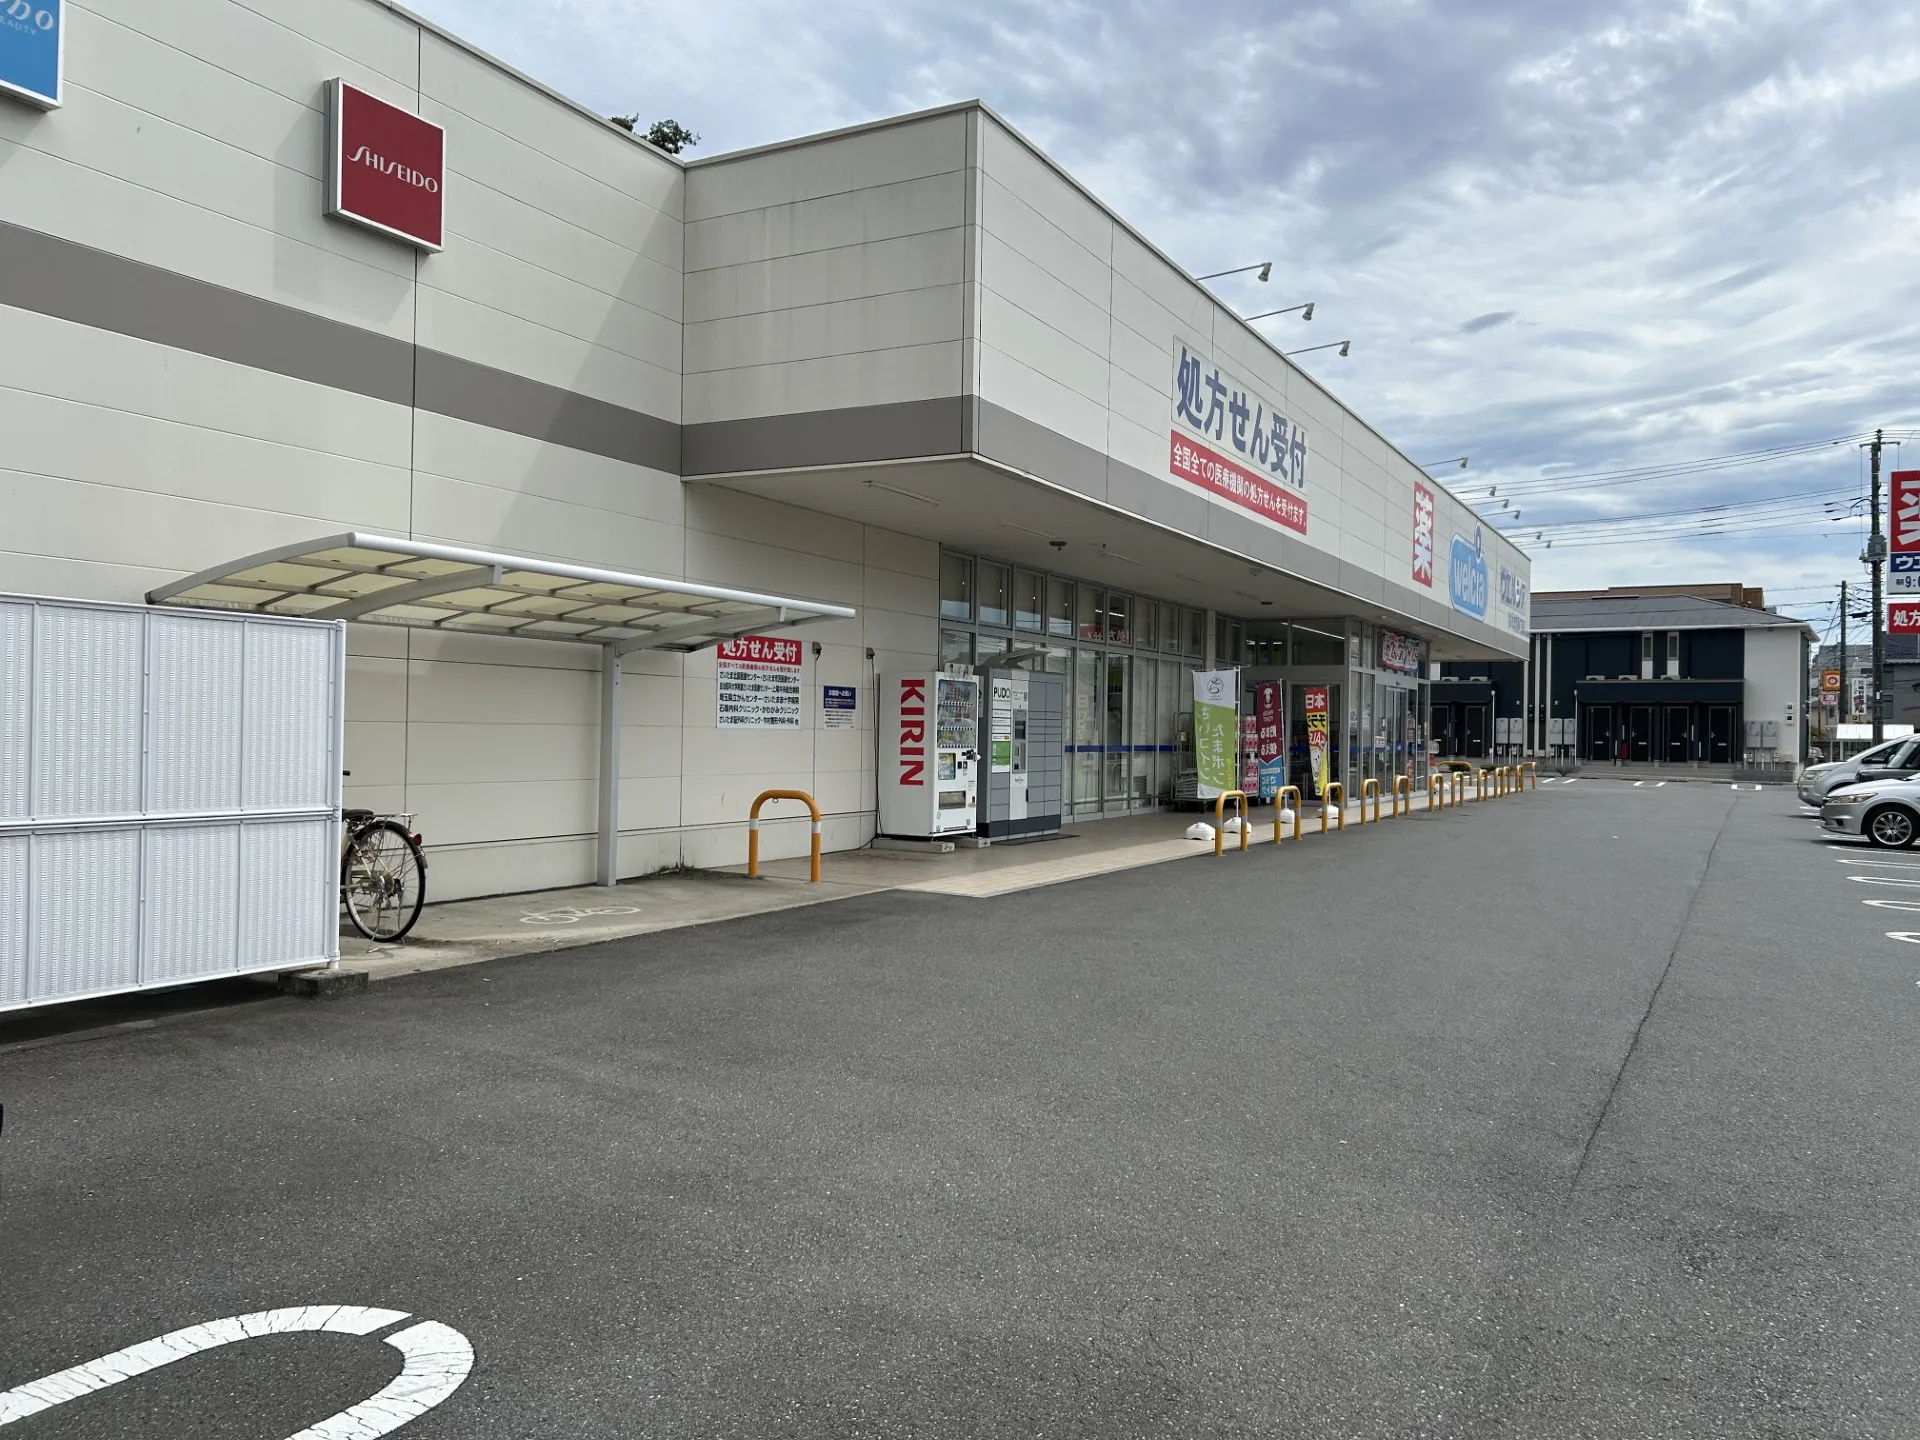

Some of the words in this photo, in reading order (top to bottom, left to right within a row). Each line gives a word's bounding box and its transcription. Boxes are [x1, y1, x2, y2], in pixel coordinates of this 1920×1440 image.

[346, 145, 439, 194] SHISEIDO
[1177, 345, 1307, 489] 処方せん受付
[1414, 488, 1433, 581] 薬
[1454, 555, 1485, 609] welcia
[723, 637, 797, 663] 処方せん受付
[993, 686, 1011, 699] PUDO
[900, 679, 925, 786] KIRIN
